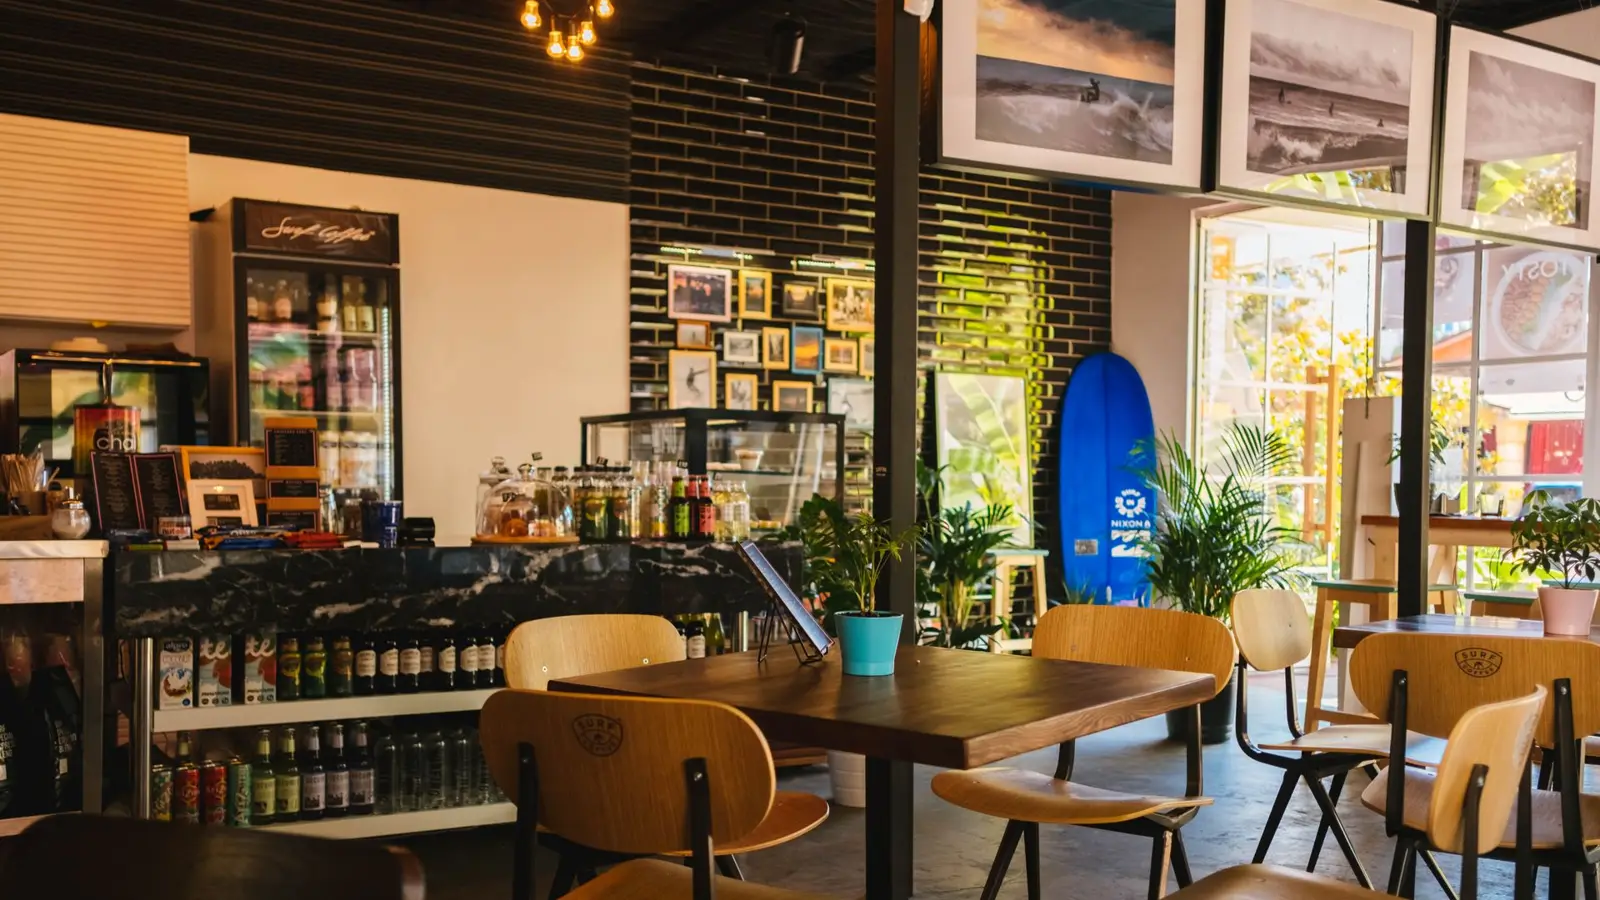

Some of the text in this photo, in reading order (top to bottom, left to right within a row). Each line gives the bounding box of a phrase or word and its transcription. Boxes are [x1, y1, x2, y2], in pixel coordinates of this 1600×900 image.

[261, 216, 321, 241] Surf
[1111, 520, 1143, 528] NIXON
[1461, 650, 1497, 660] SURF
[577, 718, 615, 730] SURF
